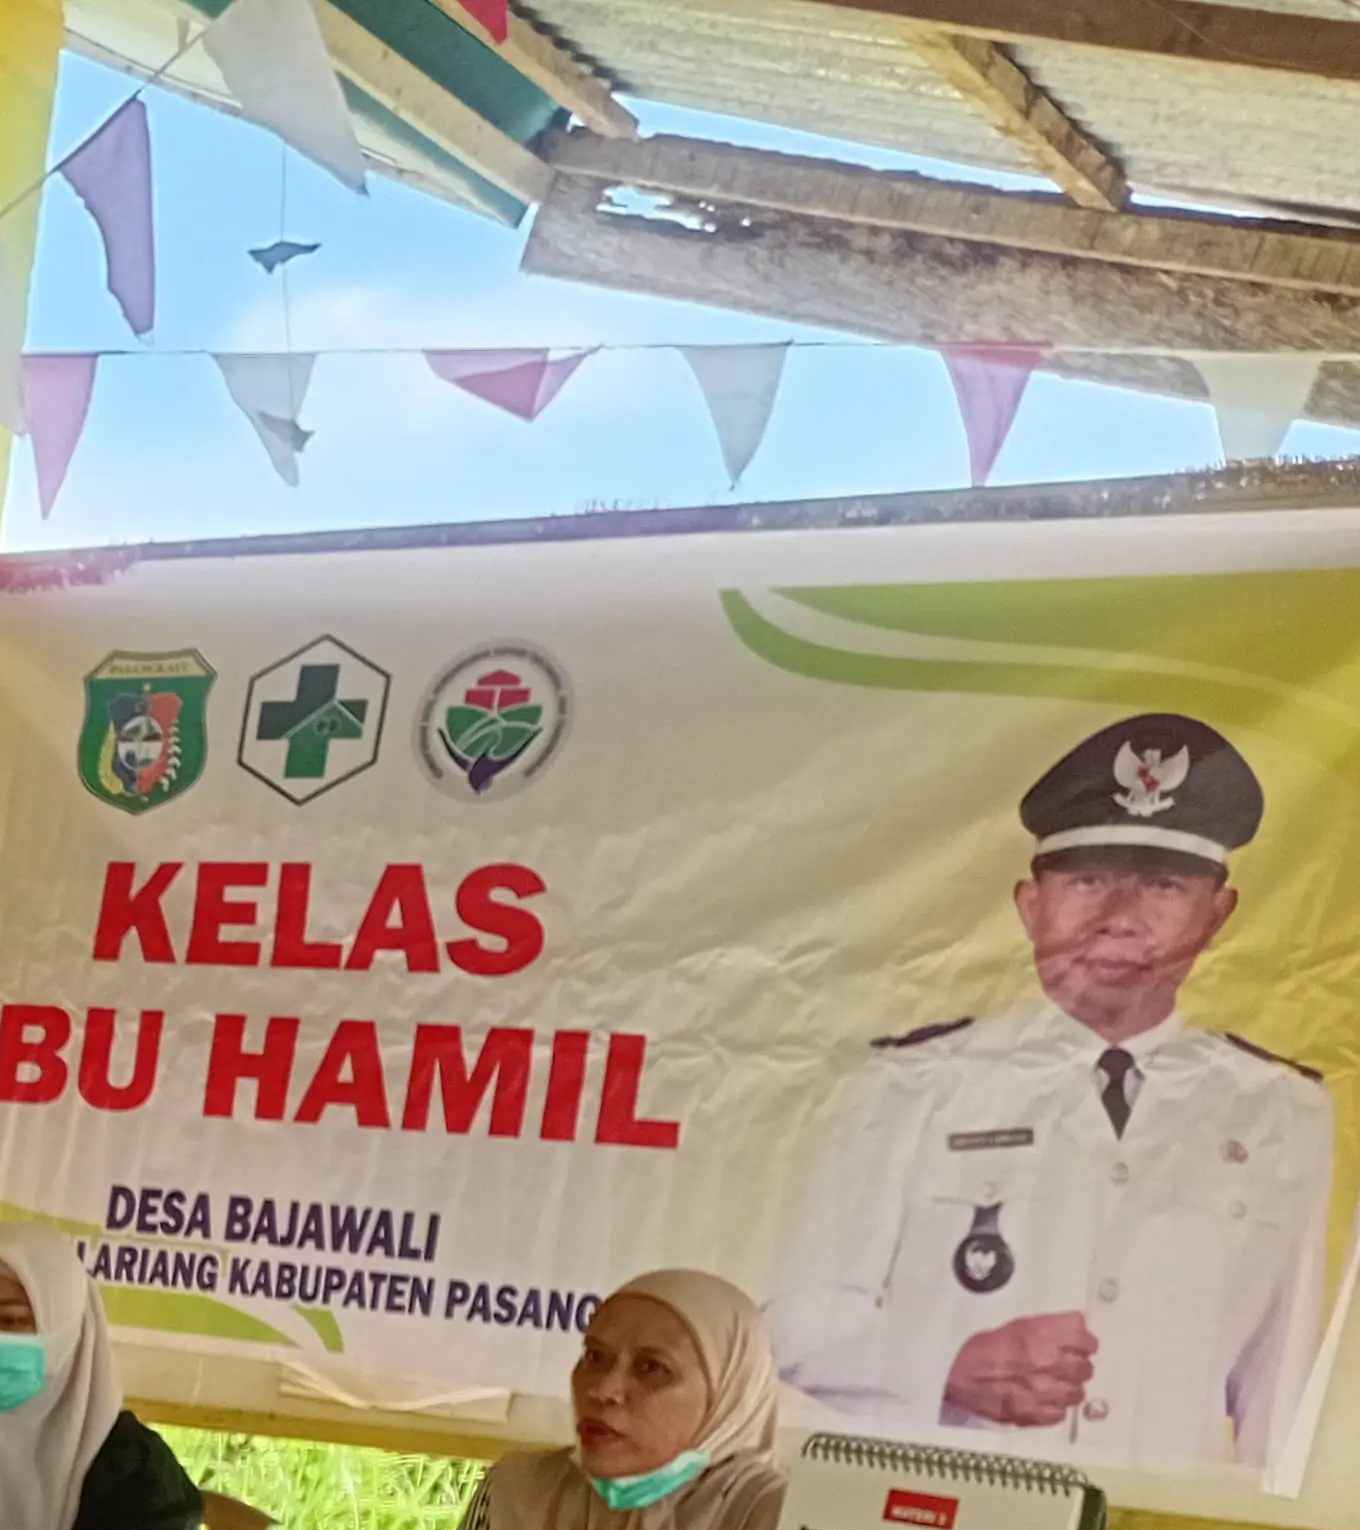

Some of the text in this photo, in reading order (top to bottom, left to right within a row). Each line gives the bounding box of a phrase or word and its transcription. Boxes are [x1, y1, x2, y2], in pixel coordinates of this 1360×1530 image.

[92, 861, 547, 976] KELAS
[202, 1012, 680, 1149] HAMIL
[105, 1185, 441, 1262] DESA BAJAWALI
[228, 1256, 436, 1317] KABUPATEN
[445, 1279, 604, 1334] PASANG
